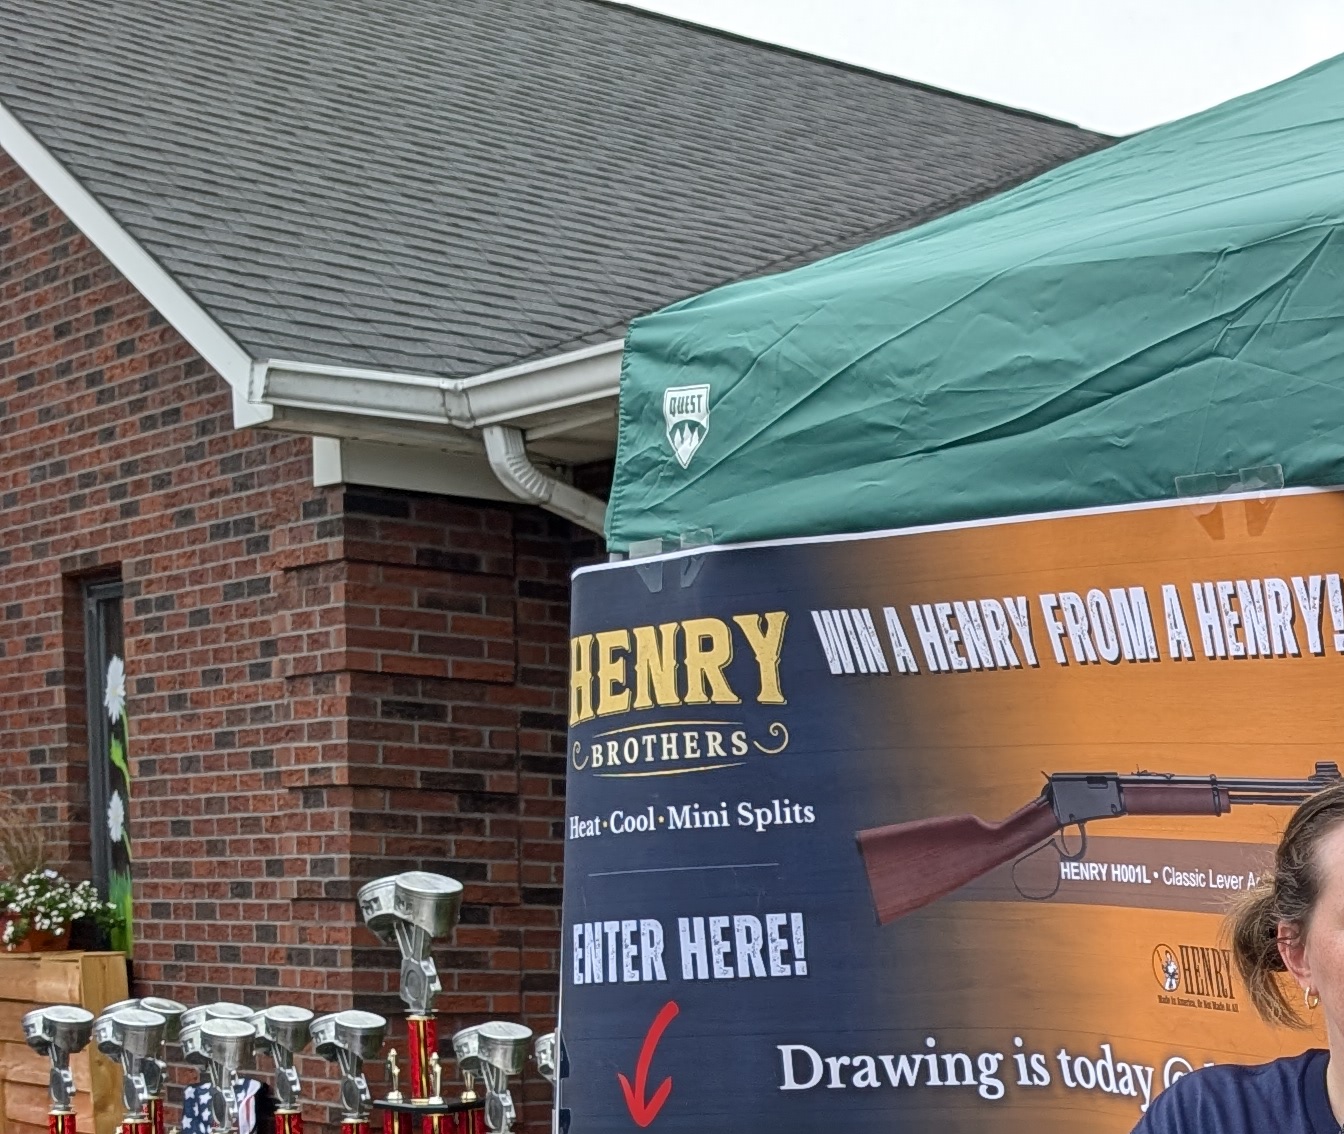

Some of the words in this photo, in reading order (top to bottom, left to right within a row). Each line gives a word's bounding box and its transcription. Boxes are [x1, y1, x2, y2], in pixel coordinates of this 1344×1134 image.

[669, 394, 703, 417] QUEST
[811, 607, 890, 676] WIN
[884, 606, 919, 674] A
[911, 596, 1038, 671] HENRY
[1040, 587, 1158, 665] FROM
[1161, 584, 1194, 659] A
[569, 611, 790, 728] HENRY
[591, 731, 749, 768] BROTHERS
[737, 798, 816, 832] Splits
[1060, 861, 1108, 882] HENRY
[1162, 866, 1207, 888] Classic
[1209, 868, 1244, 890] Lever
[573, 919, 668, 985] ENTER
[677, 912, 809, 981] HERE!
[1178, 944, 1236, 999] HENRY
[776, 1036, 1006, 1100] Drawing
[1013, 1036, 1051, 1087] is
[1057, 1043, 1154, 1112] today
